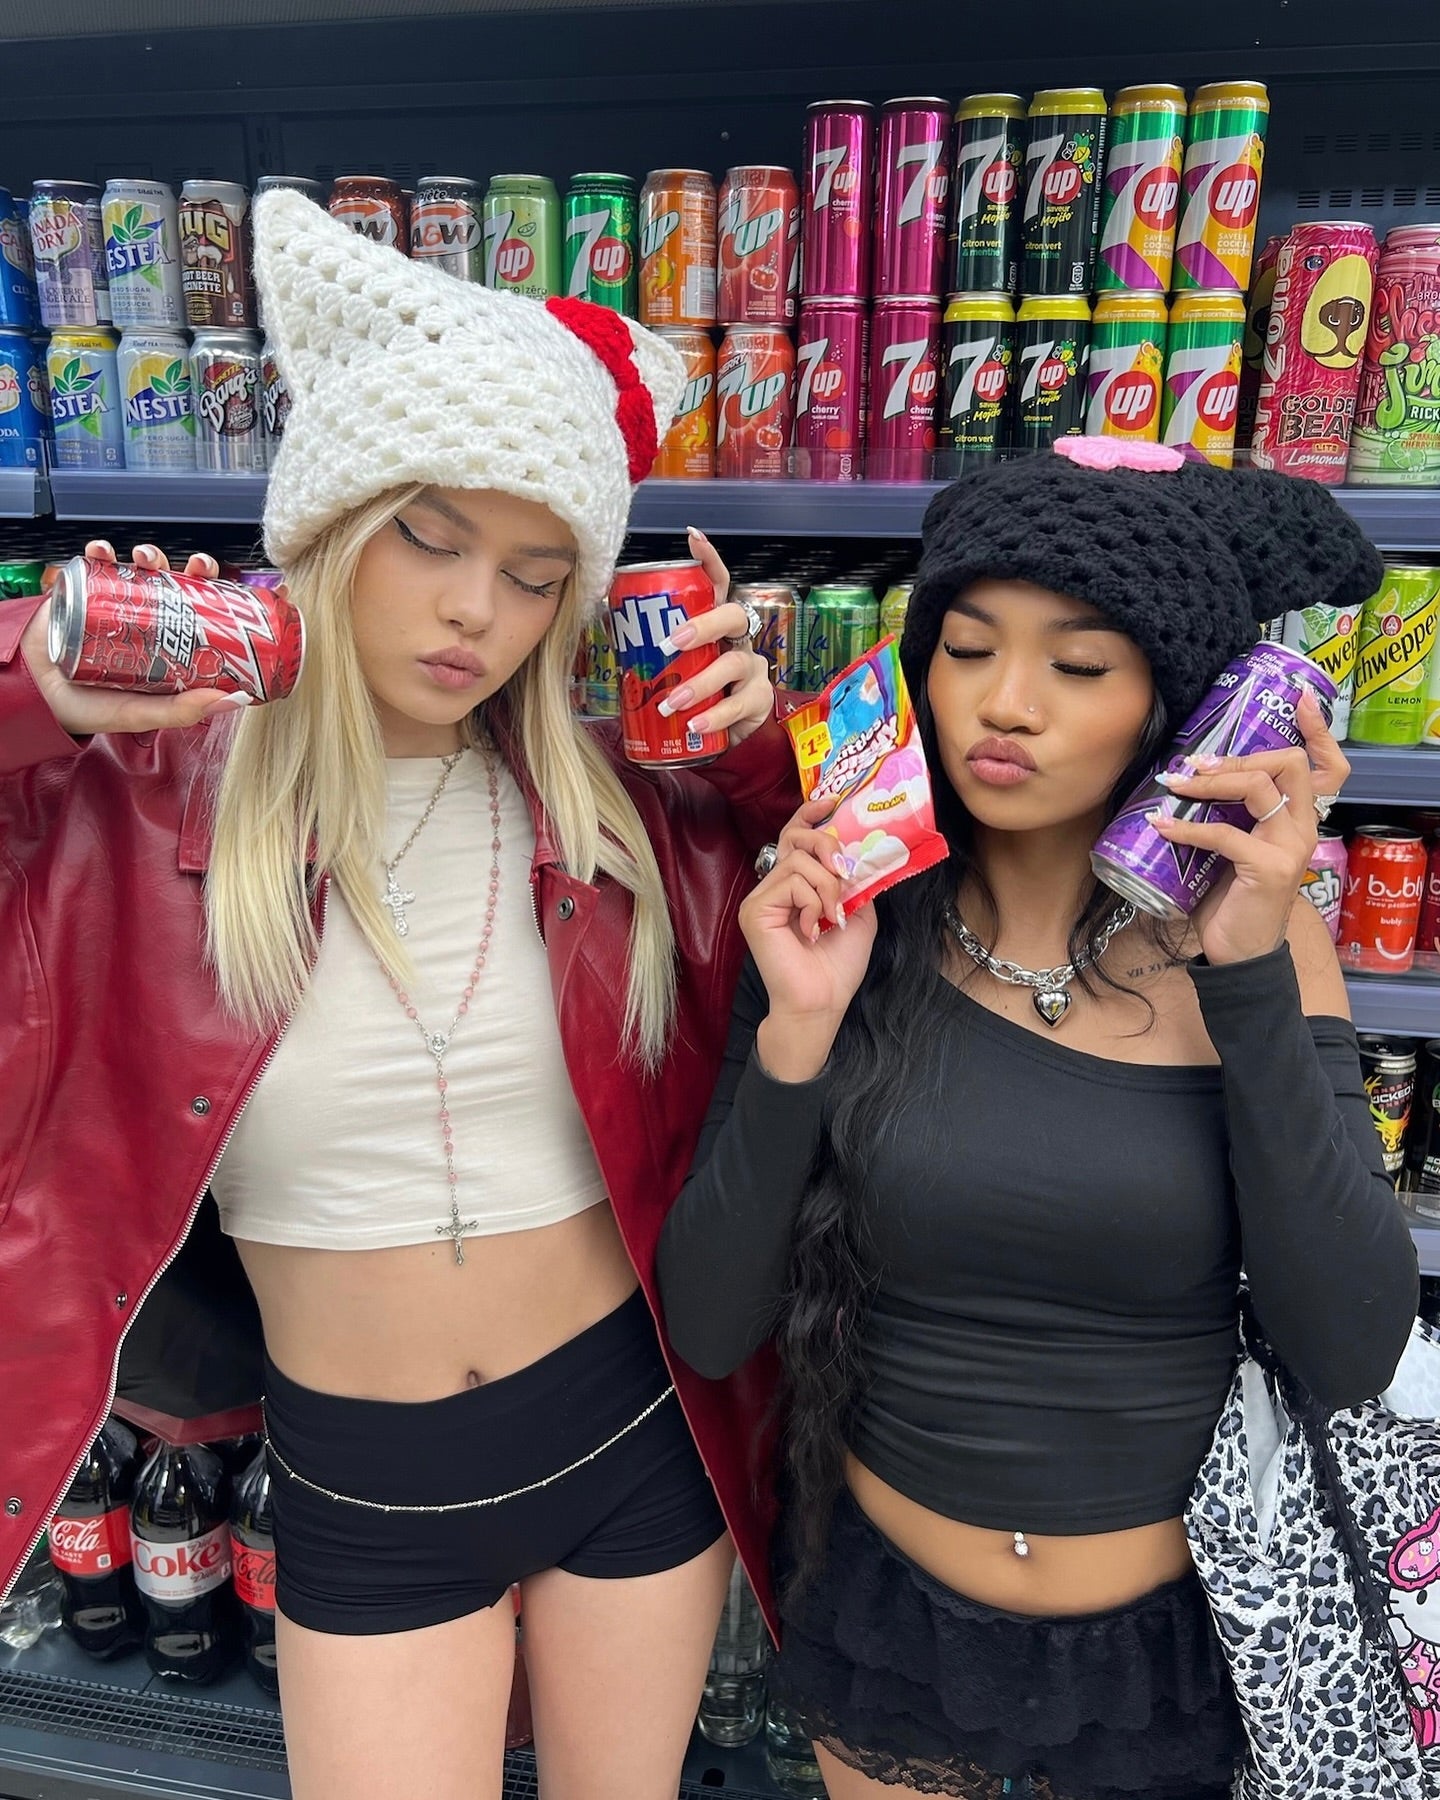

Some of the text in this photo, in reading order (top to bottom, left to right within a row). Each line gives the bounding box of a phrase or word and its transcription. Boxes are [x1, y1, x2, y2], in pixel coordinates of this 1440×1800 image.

[896, 141, 949, 226] 7up
[1023, 133, 1077, 224] 7up
[1100, 138, 1179, 254] 7up
[1175, 134, 1257, 253] 7up
[1040, 210, 1074, 228] Mojito
[38, 230, 66, 252] DRY
[566, 208, 626, 297] 7up
[962, 239, 986, 249] citron
[1044, 241, 1062, 250] vert
[106, 242, 171, 272] ESTEA
[195, 271, 221, 283] BEER
[69, 294, 91, 304] ALE
[796, 337, 842, 419] 7up
[882, 338, 936, 421] 7up
[949, 336, 1005, 419] 7up
[1020, 340, 1066, 403] 7up
[52, 392, 108, 420] ESTEA
[126, 394, 191, 424] NESTE
[200, 367, 258, 433] Barq's
[811, 404, 841, 416] cherry
[909, 404, 935, 416] cherry
[972, 407, 1003, 422] Mojito
[978, 401, 1001, 411] saveur
[1023, 414, 1054, 423] citron vert
[954, 434, 994, 443] citron vert
[1315, 444, 1338, 453] LITE
[162, 587, 182, 658] RED
[177, 604, 195, 668] CODE
[612, 594, 689, 654] NTA
[758, 613, 788, 663] La
[805, 613, 830, 663] La
[1387, 696, 1422, 705] LEMON
[1381, 917, 1403, 926] bubly
[1370, 1085, 1411, 1104] UCKED
[133, 1539, 222, 1578] Coke
[187, 1535, 214, 1553] Diet
